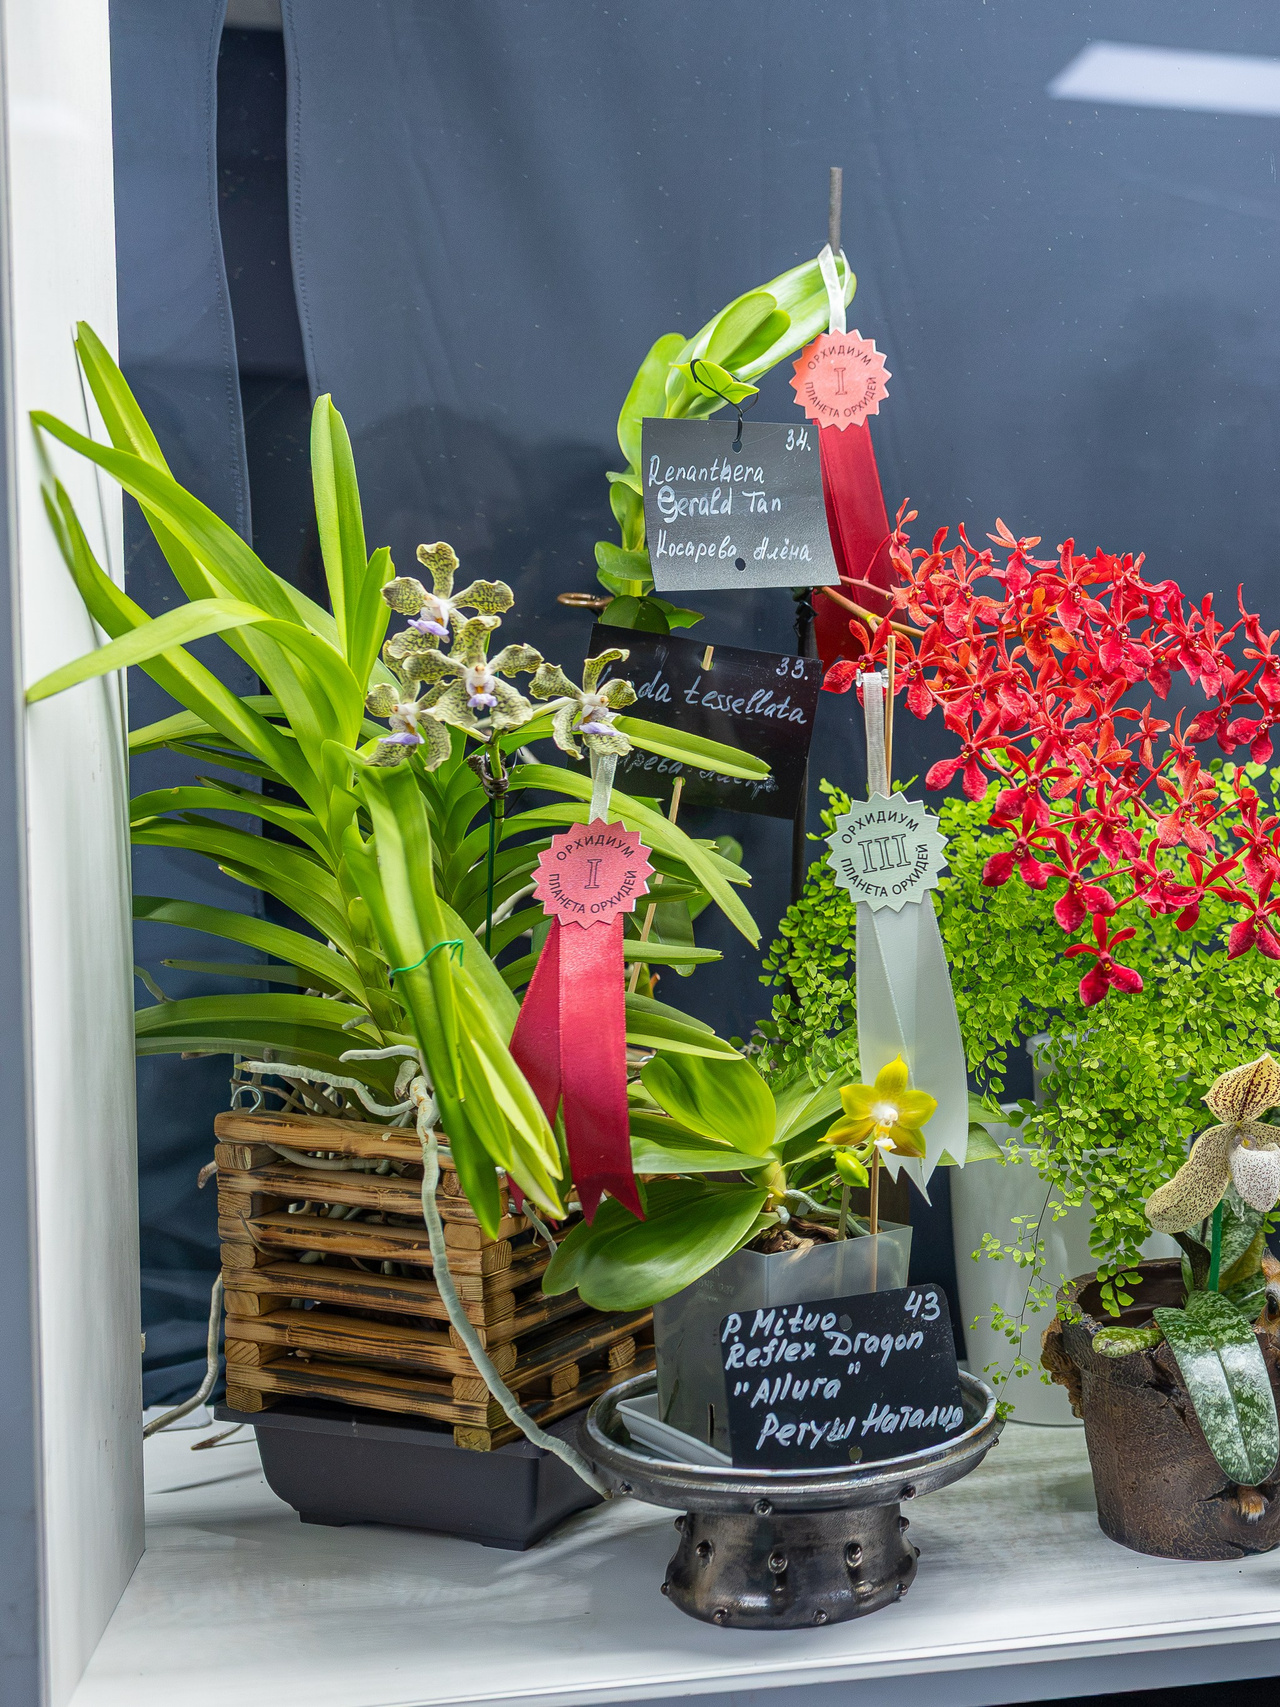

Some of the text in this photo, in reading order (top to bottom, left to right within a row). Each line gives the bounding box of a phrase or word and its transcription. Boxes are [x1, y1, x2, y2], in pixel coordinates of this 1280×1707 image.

[808, 345, 871, 370] ОРХИДИУМ
[805, 377, 876, 417] ПЛАНЕТА ОРХИДЕЙ
[834, 367, 847, 395] I
[648, 455, 765, 487] Renanthera
[657, 485, 781, 523] Gerald Tan
[684, 675, 807, 724] tessellata
[842, 811, 919, 843] ОРХИДИУМ
[557, 835, 634, 860] ОРХИДИУМ
[858, 834, 911, 873] III
[585, 859, 602, 889] I
[841, 844, 929, 897] ПЛАНЕТА ОРХИДЕЙ
[549, 871, 637, 913] ПЛАНЕТА ОРХИДЕЙ
[750, 1305, 836, 1337] Mituo
[904, 1291, 940, 1320] 43
[725, 1330, 923, 1370] Reflex Dragon
